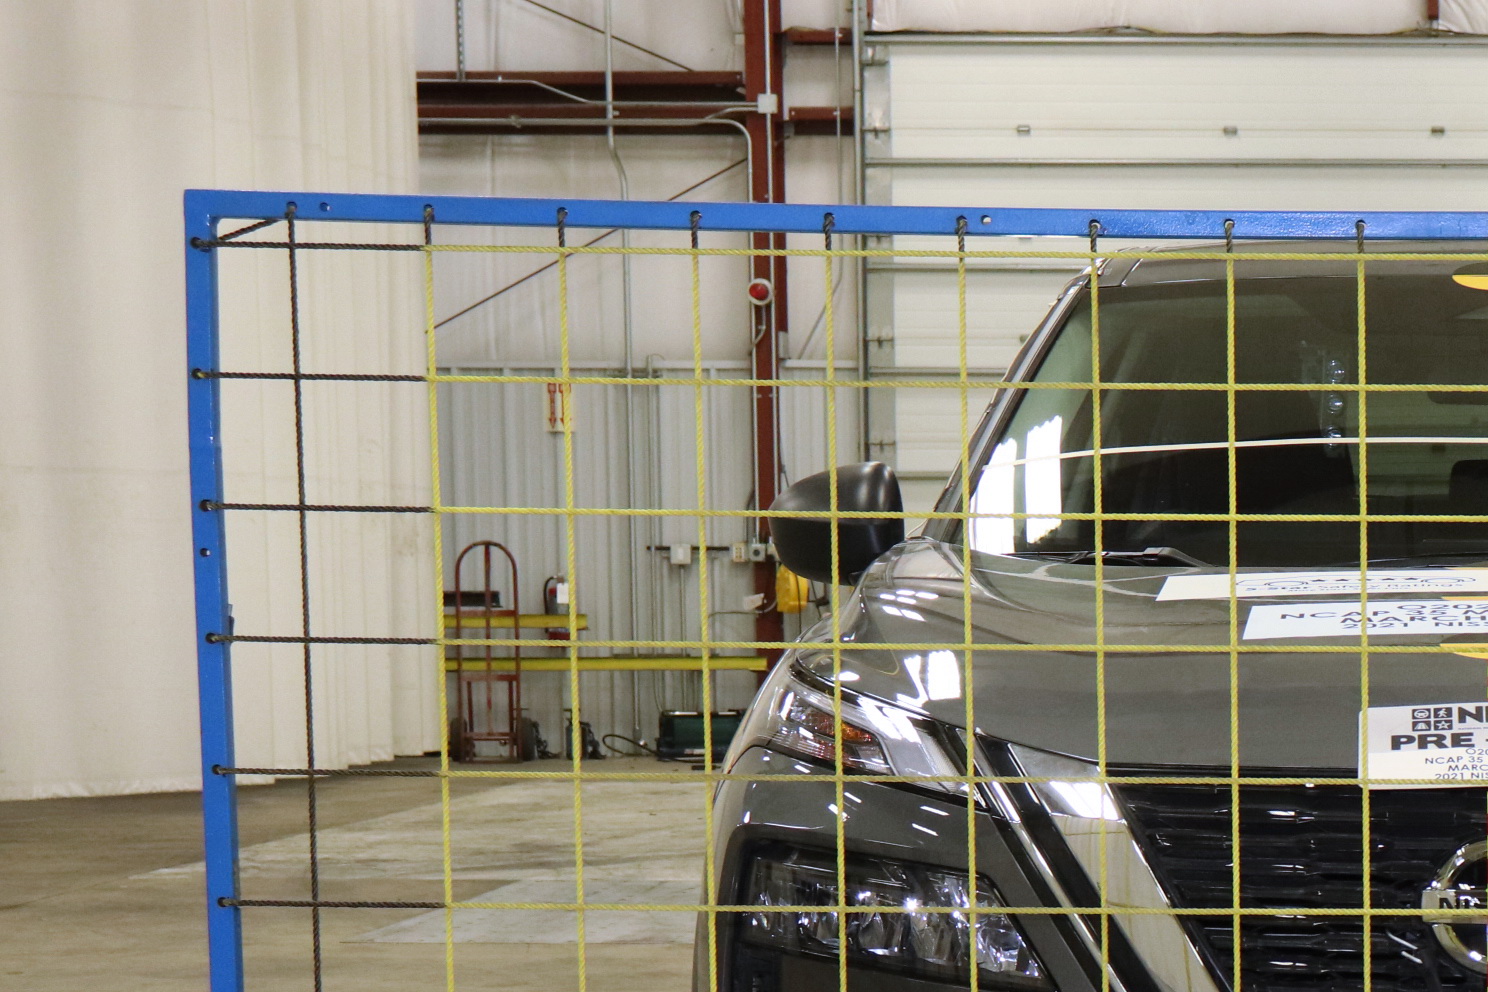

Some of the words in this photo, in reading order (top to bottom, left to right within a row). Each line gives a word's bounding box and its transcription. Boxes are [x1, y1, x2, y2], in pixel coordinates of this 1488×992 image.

[1281, 611, 1390, 620] NCAP
[1340, 615, 1487, 623] MARCH
[1391, 732, 1475, 750] PRE
[1424, 756, 1463, 764] NCAP
[1435, 772, 1464, 780] 2021
